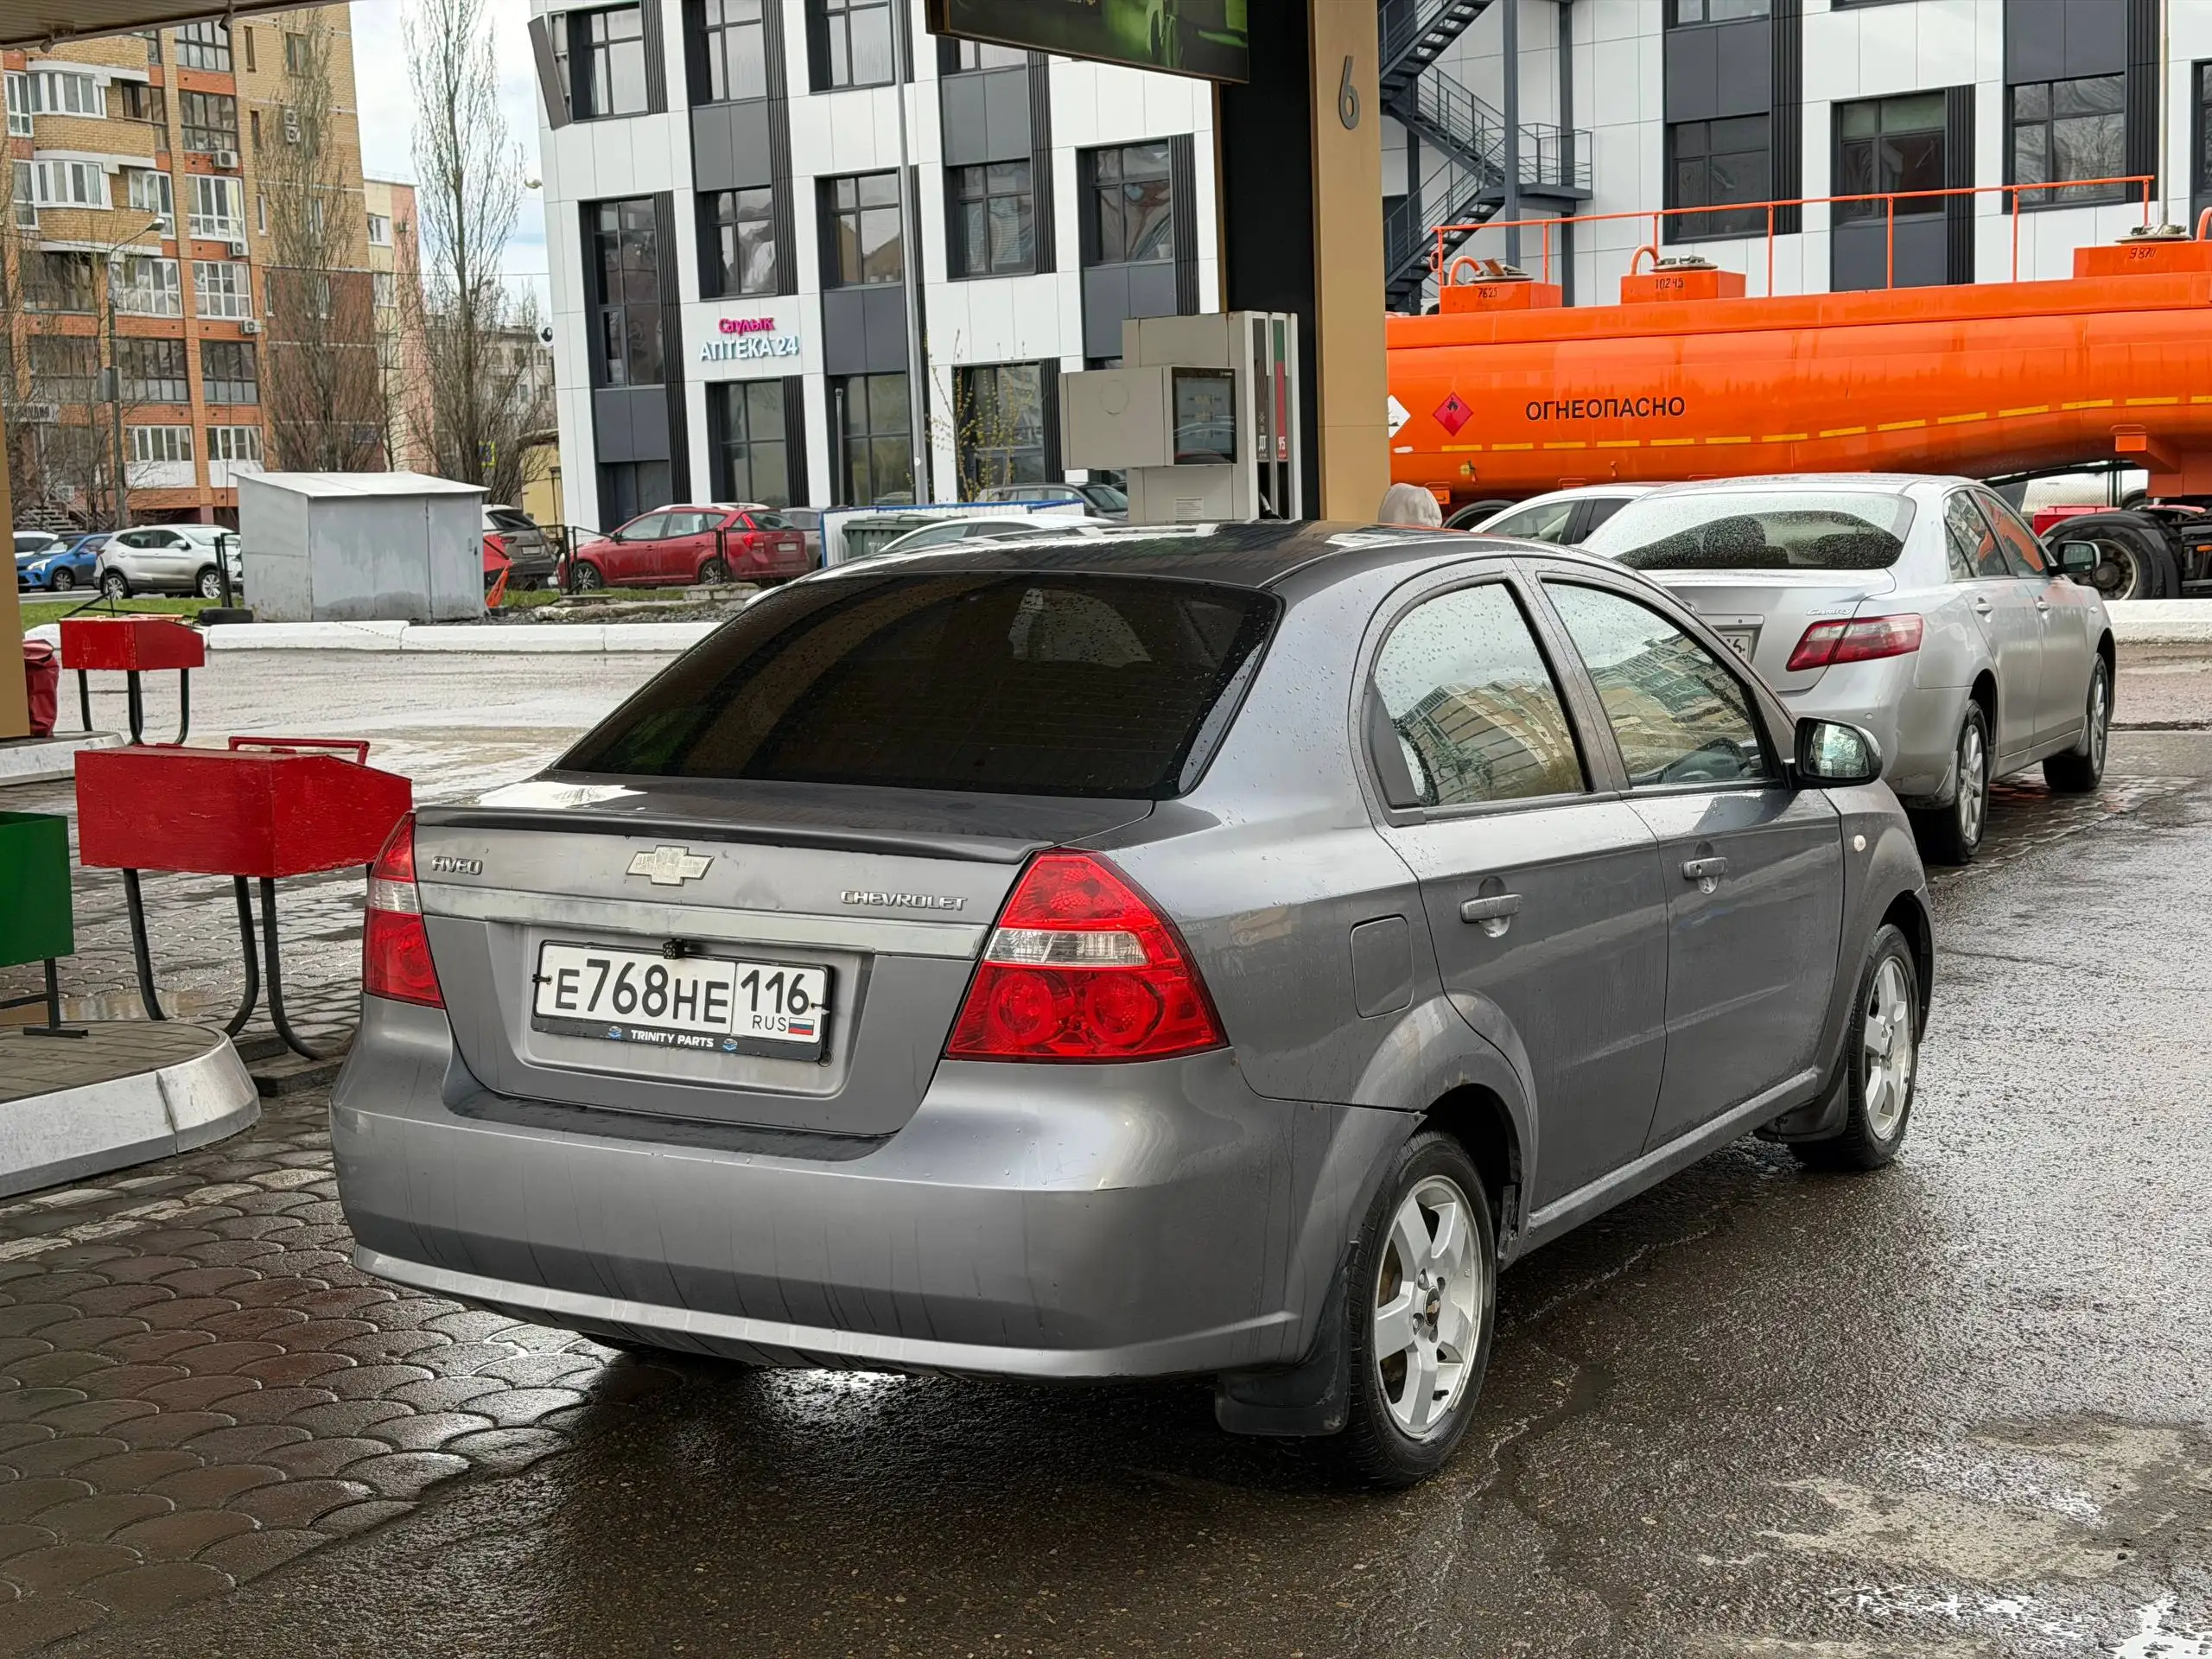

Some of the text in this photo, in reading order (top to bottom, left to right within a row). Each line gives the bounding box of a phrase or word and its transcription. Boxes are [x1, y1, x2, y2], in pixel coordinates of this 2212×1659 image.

[1338, 54, 1360, 130] 6
[1656, 277, 1684, 289] 10245
[719, 317, 775, 336] Саулык
[699, 335, 798, 361] АПТЕКА 24
[1525, 396, 1685, 421] ОГНЕОПАСНО
[432, 855, 483, 875] AVEO
[841, 890, 968, 911] CHEVROLET
[741, 969, 810, 1015] 116
[752, 1014, 786, 1032] RUS
[631, 1029, 714, 1048] TRINITY PARTS
